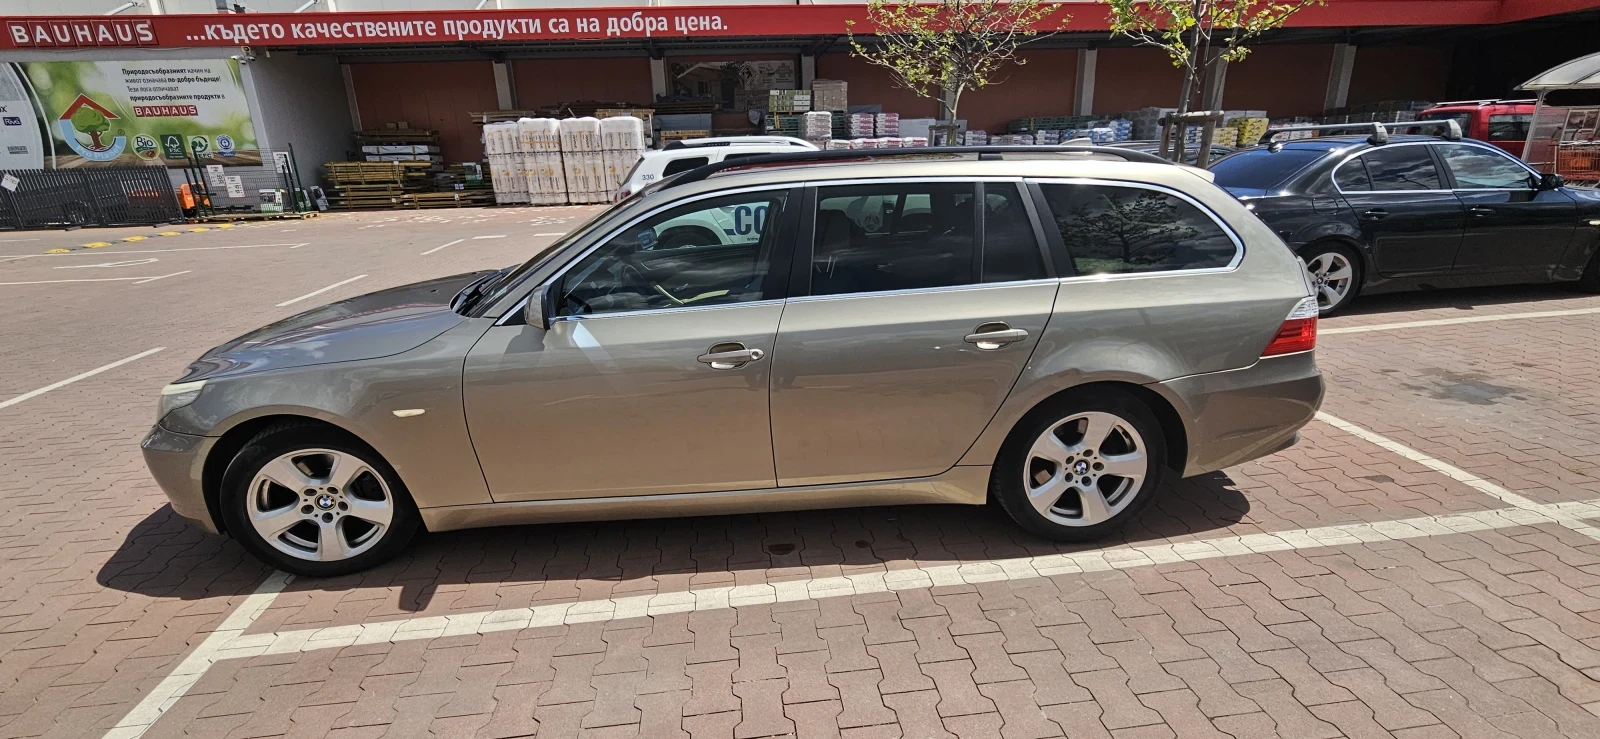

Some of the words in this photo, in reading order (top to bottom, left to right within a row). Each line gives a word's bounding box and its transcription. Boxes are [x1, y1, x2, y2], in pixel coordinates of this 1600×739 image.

[10, 22, 153, 44] BAUHAUS
[186, 22, 285, 44] ...където
[291, 19, 436, 39] качествените
[443, 18, 541, 39] продукти
[548, 17, 569, 33] са
[576, 17, 600, 33] на
[606, 11, 668, 36] добра
[674, 15, 729, 35] цена.
[193, 93, 221, 101] продукти
[134, 106, 197, 116] BAUHAUS
[136, 136, 153, 147] Bio
